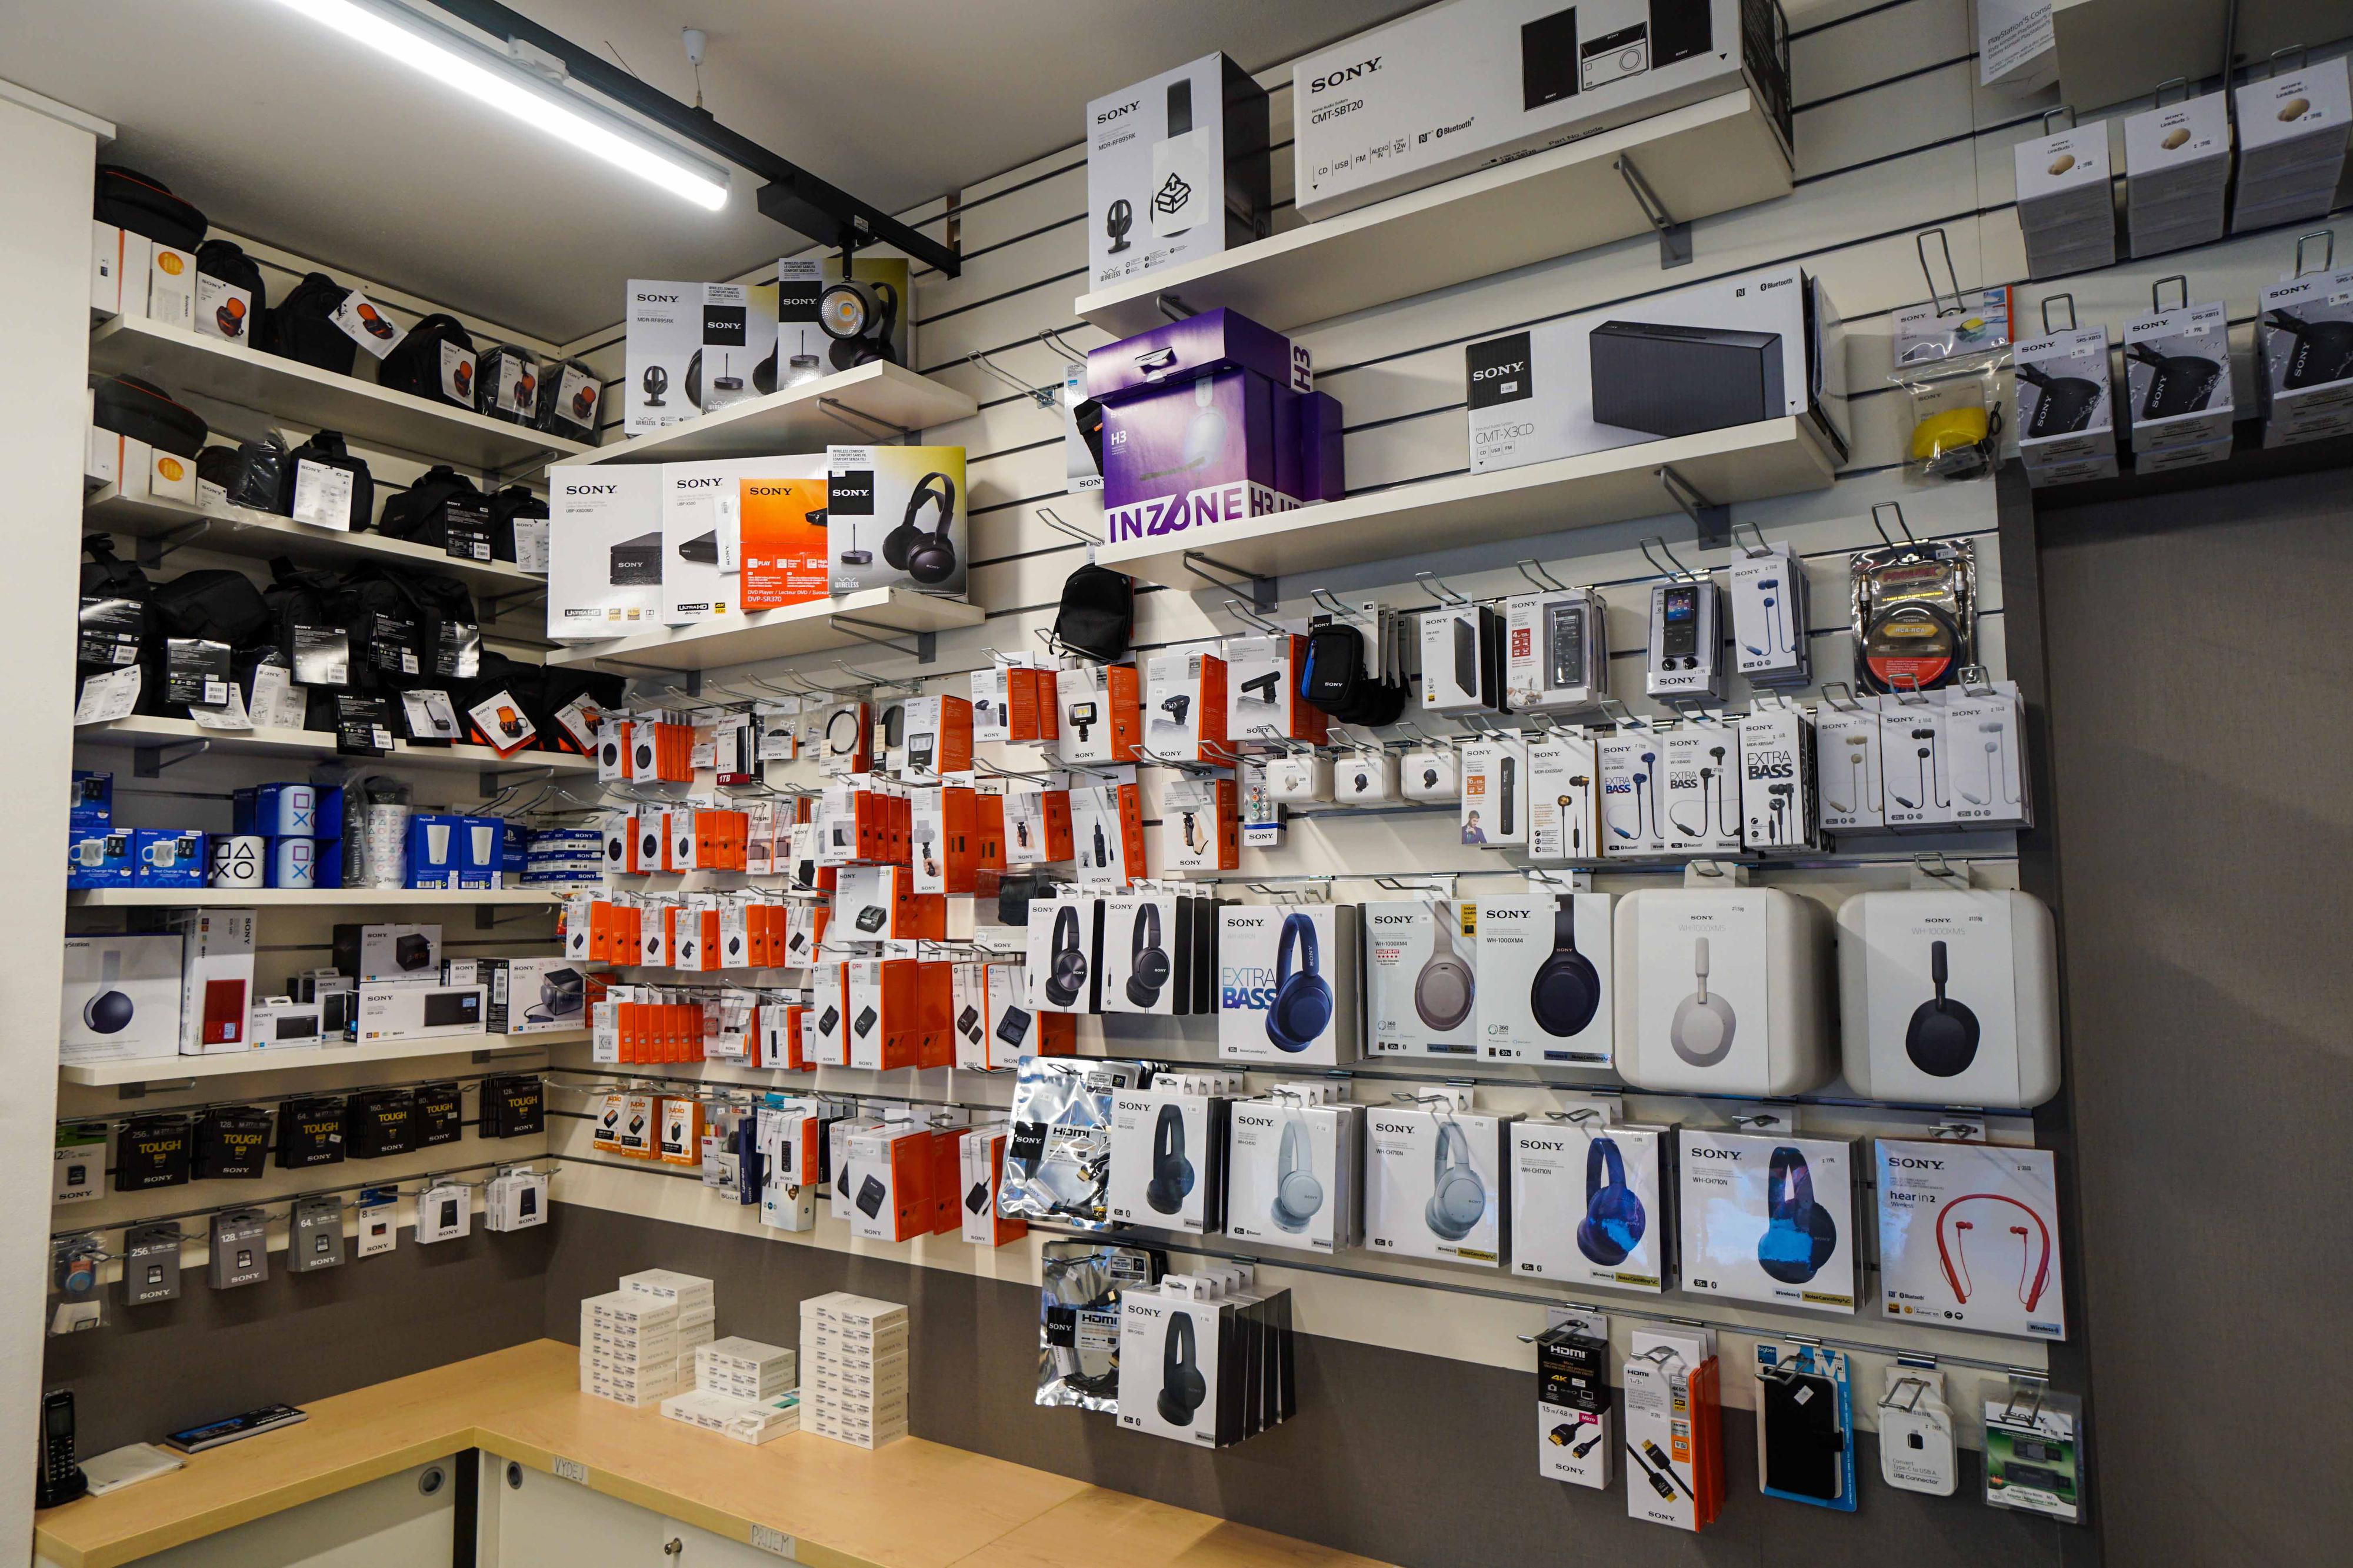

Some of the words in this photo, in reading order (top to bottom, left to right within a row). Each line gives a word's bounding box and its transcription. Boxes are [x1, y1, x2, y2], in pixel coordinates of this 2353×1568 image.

[1311, 57, 1382, 93] SONY
[1098, 101, 1140, 125] SONY
[1312, 99, 1364, 124] CMT-SBT20
[1444, 120, 1471, 135] Bluetooth
[1568, 133, 1582, 142] No.
[1585, 125, 1604, 135] code
[1098, 133, 1136, 151] MDR-RF895RK
[1372, 145, 1388, 155] AUDIO
[1335, 160, 1349, 170] USB
[1355, 155, 1366, 164] FM
[1318, 166, 1328, 175] CD
[1100, 271, 1121, 282] WIRELESS
[201, 278, 222, 290] SONY
[1767, 278, 1792, 289] Bluetooth
[2270, 283, 2311, 298] SONY
[637, 294, 679, 302] SONY
[1901, 313, 1926, 322] SONY
[2192, 311, 2219, 321] SRS-XB13
[2132, 320, 2168, 332] SONY
[2076, 335, 2101, 343] SRS-XB13
[2022, 342, 2055, 352] SONY
[1294, 346, 1311, 391] H3
[1473, 361, 1523, 381] SONY
[1111, 431, 1127, 445] H3
[1475, 423, 1534, 445] CMT-X3CD
[301, 464, 322, 473] SONY
[566, 486, 617, 495] SONY
[1250, 488, 1274, 518] H3
[1109, 488, 1243, 543] INZONE
[1884, 567, 1937, 581] PROLINK
[1747, 750, 1792, 765] EXTRA
[1748, 763, 1793, 780] BASS
[719, 775, 731, 783] 1TB
[1671, 779, 1697, 789] BASS
[1606, 785, 1631, 793] BASS
[1487, 910, 1531, 919] SONY
[1228, 919, 1264, 927] SONY
[1222, 968, 1276, 987] EXTRA
[1222, 987, 1277, 1009] BASS
[508, 1096, 537, 1107] TOUGH
[1119, 1101, 1151, 1112] SONY
[426, 1103, 453, 1113] TOUGH
[379, 1112, 406, 1122] TOUGH
[1238, 1116, 1273, 1127] SONY
[303, 1122, 338, 1133] TOUGH
[1053, 1127, 1089, 1137] HDMI
[1376, 1123, 1415, 1135] SONY
[224, 1135, 262, 1144] TOUGH
[139, 1140, 181, 1153] TOUGH
[1521, 1140, 1564, 1151] SONY
[1692, 1147, 1742, 1160] SONY
[1889, 1158, 1944, 1170] SONY
[1692, 1177, 1728, 1186] WH-CH710N
[1891, 1191, 1915, 1201] h.ear
[1918, 1193, 1928, 1202] in
[310, 1257, 336, 1266] SONY
[231, 1273, 259, 1283] SONY
[140, 1290, 169, 1299] SONY
[1821, 1295, 1842, 1303] Canceling
[1128, 1305, 1161, 1317] SONY
[1082, 1314, 1117, 1325] HDMI
[1551, 1346, 1585, 1359] HDMI
[555, 1457, 584, 1480] VYDEJ
[1555, 1463, 1585, 1474] SONY
[1907, 1476, 1938, 1484] Connector
[1648, 1512, 1675, 1522] SONY
